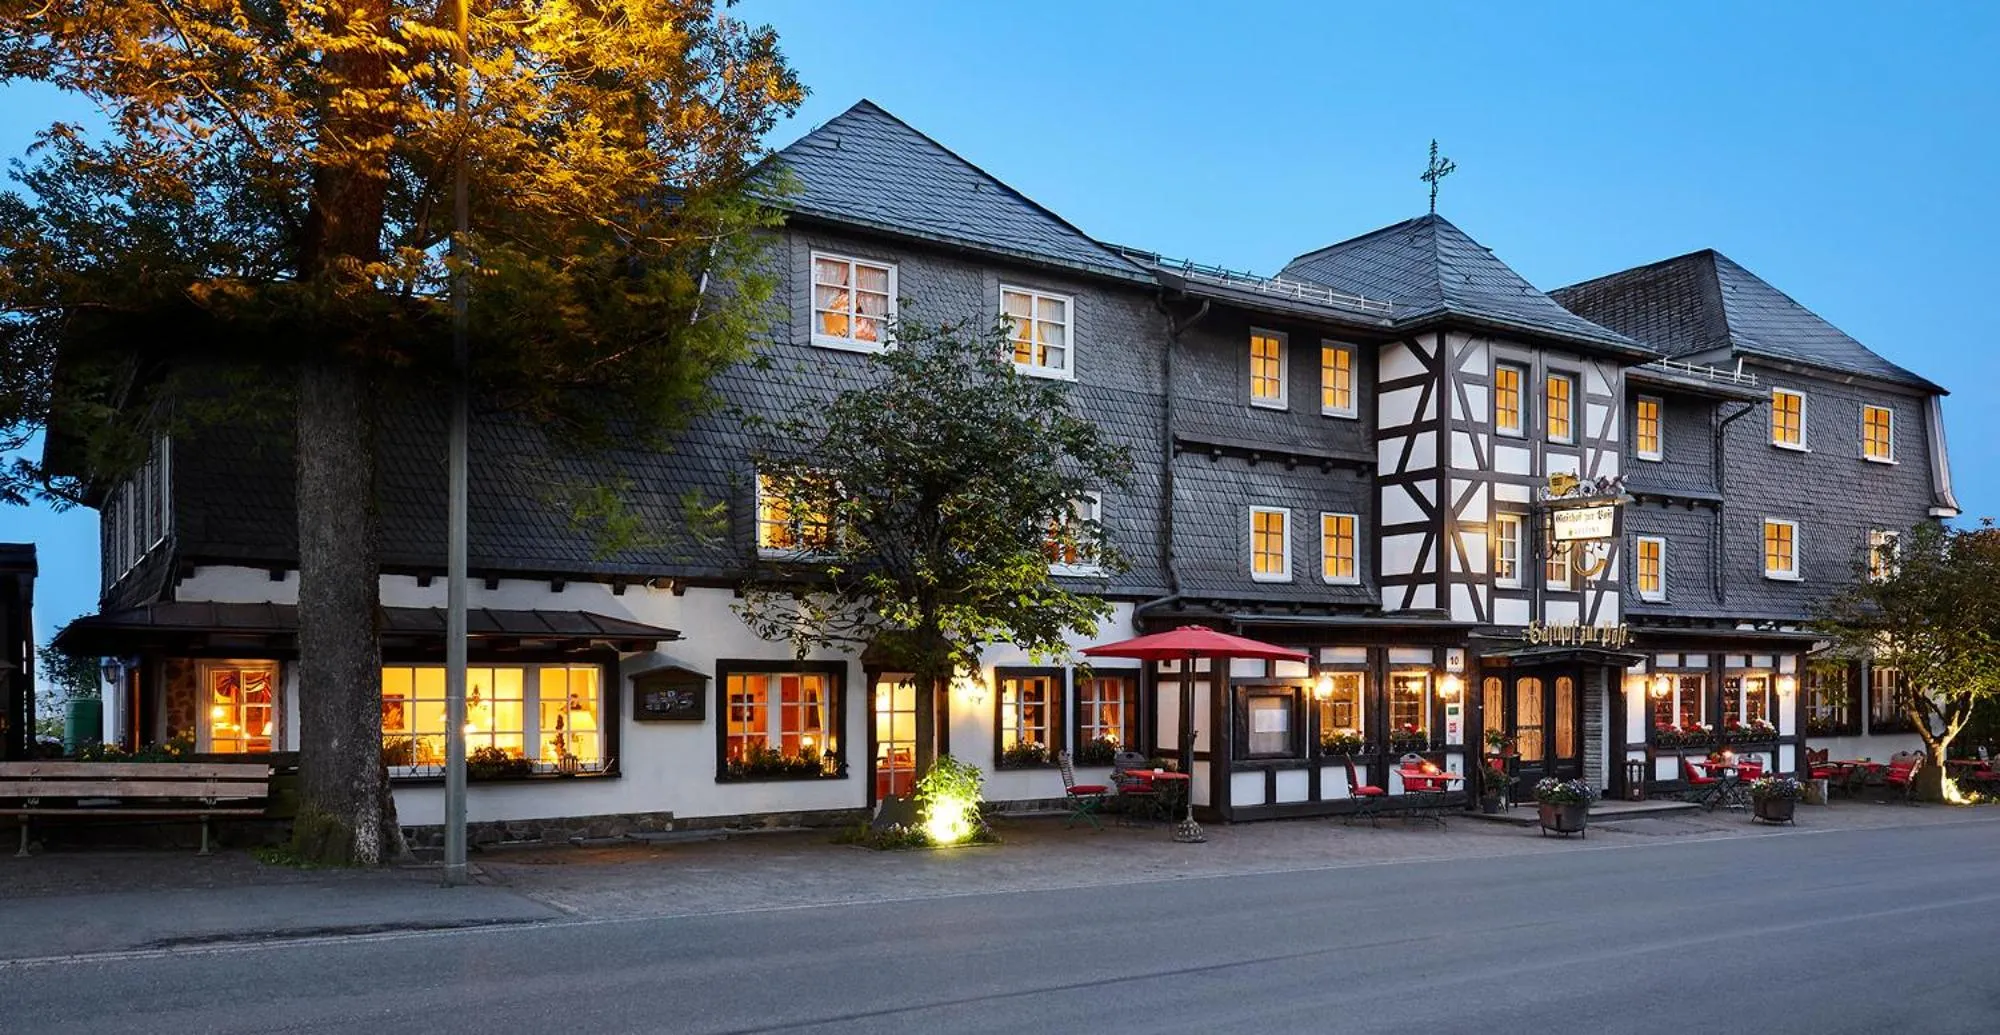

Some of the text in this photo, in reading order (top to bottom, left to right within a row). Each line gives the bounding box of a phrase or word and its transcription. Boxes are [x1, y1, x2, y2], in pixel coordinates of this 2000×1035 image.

[1529, 620, 1627, 649] Gasthof zur Post
[1450, 655, 1459, 665] 10
